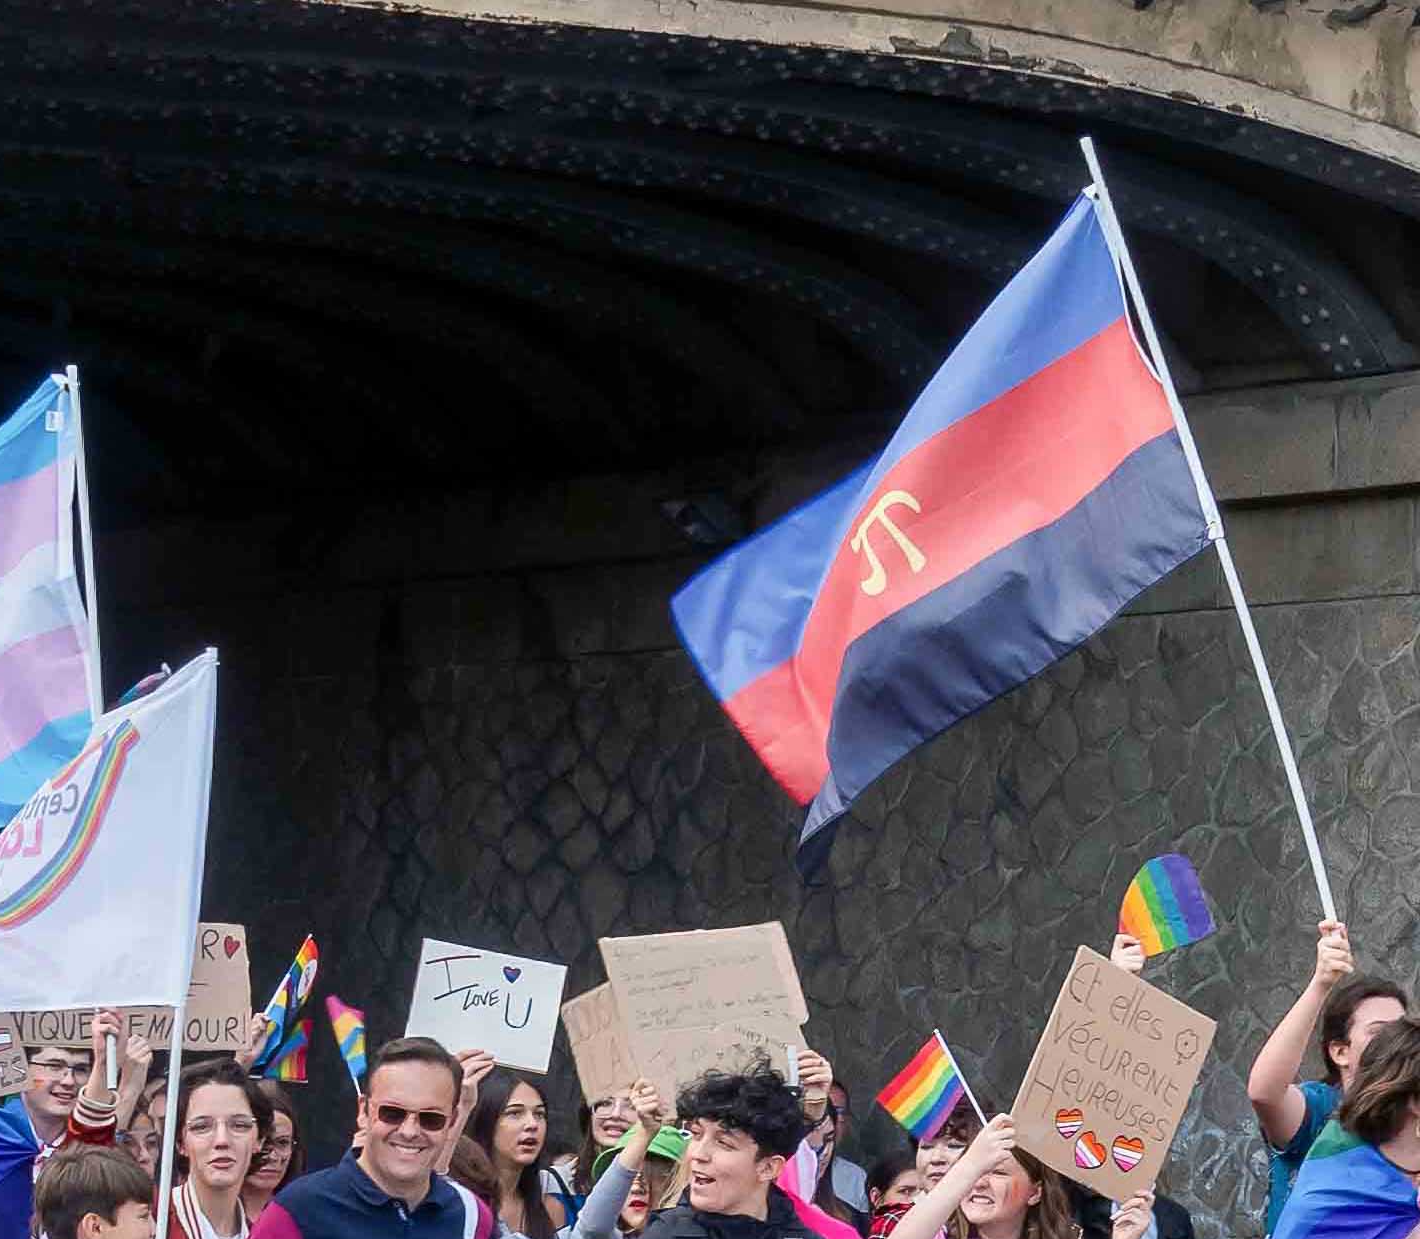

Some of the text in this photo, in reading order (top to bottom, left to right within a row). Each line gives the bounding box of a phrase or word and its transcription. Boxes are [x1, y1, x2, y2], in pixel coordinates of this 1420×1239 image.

[425, 955, 482, 1001] I
[505, 993, 533, 1029] U
[1109, 985, 1163, 1041] elles
